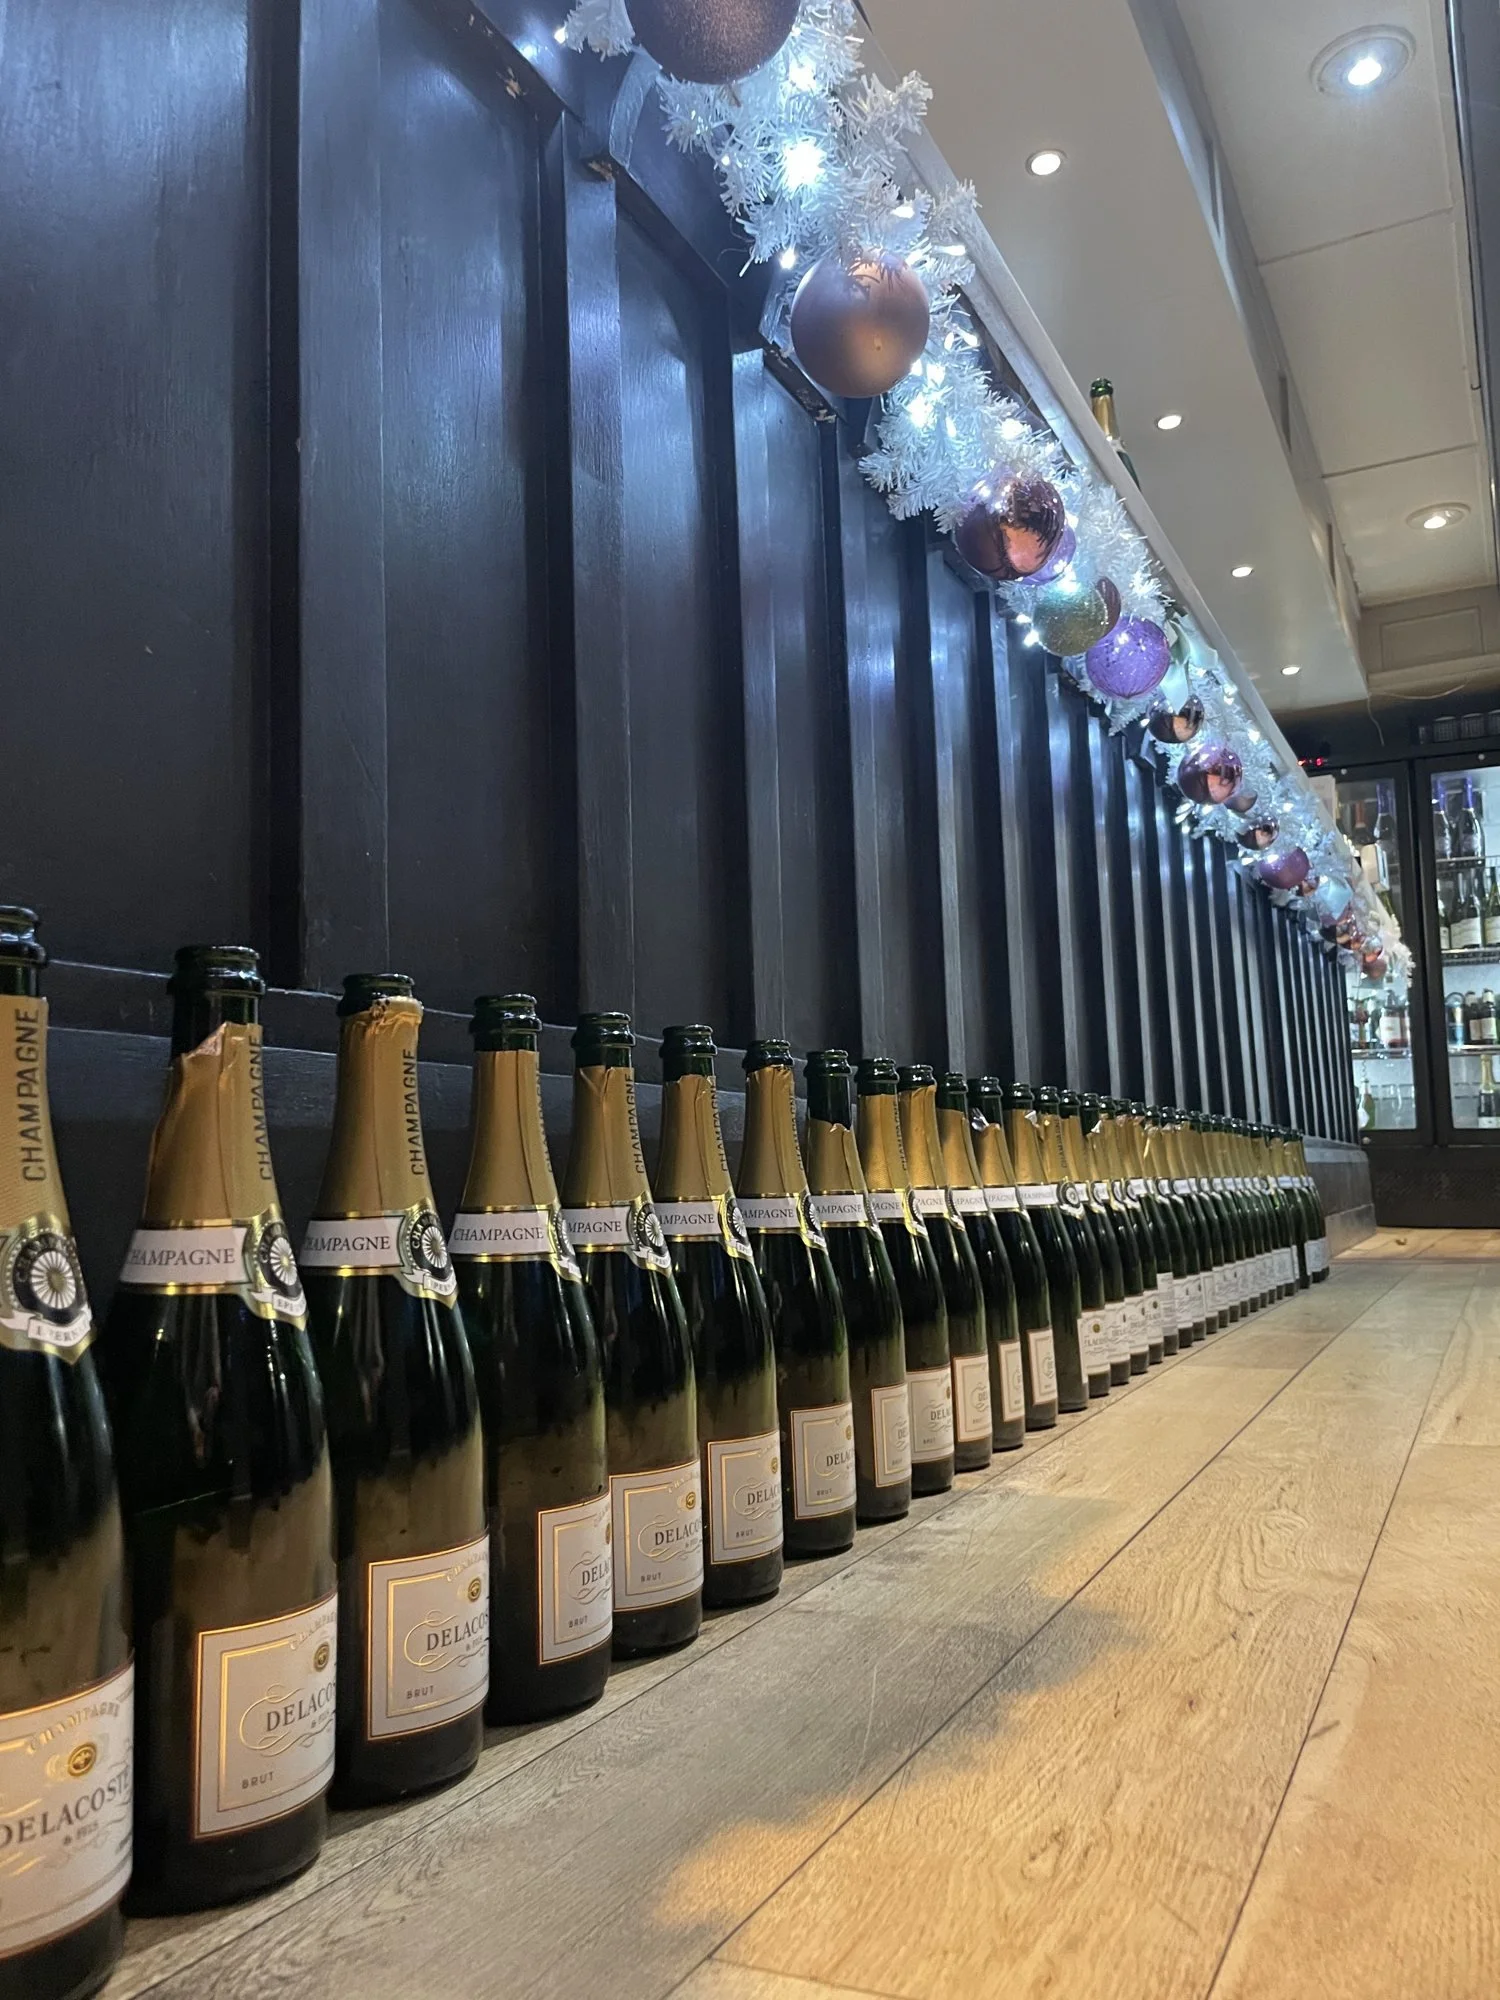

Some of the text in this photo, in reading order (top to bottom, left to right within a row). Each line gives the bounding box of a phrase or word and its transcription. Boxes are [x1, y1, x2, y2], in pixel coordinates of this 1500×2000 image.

[16, 1008, 47, 1181] CHAMPAGNE
[402, 1049, 425, 1175] CHAMPAGNE
[815, 1204, 863, 1214] AMPAGNE
[871, 1202, 900, 1210] PAGNE
[916, 1198, 943, 1206] PAGNE
[741, 1209, 795, 1219] AMPAGNE
[453, 1227, 544, 1242] CHAMPAGNE
[568, 1220, 622, 1234] MPAGNE
[129, 1247, 236, 1266] HAMPAGNE
[406, 1685, 435, 1700] BRUT
[241, 1771, 275, 1790] BRUT
